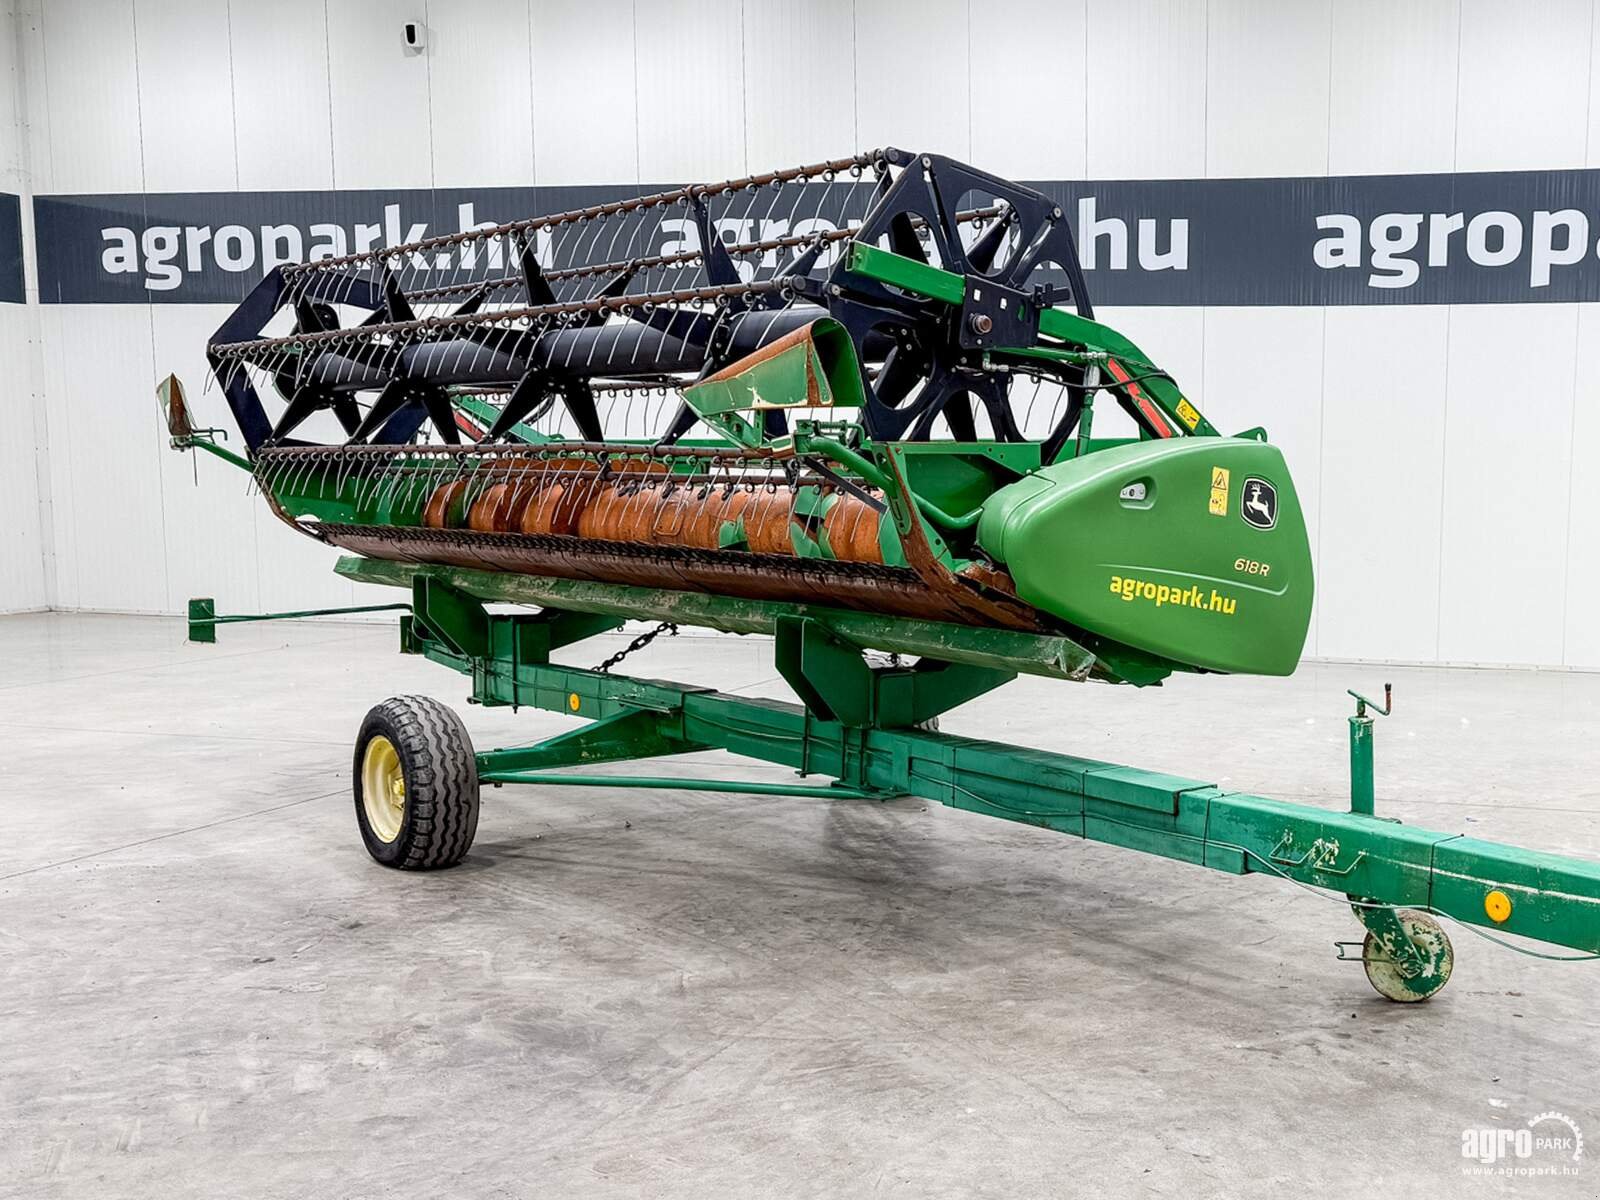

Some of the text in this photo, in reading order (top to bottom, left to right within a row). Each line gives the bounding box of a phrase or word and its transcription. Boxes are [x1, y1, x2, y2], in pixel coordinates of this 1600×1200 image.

[1313, 209, 1600, 288] agrop
[1234, 558, 1270, 577] 618R
[1109, 575, 1237, 615] agropark.hu
